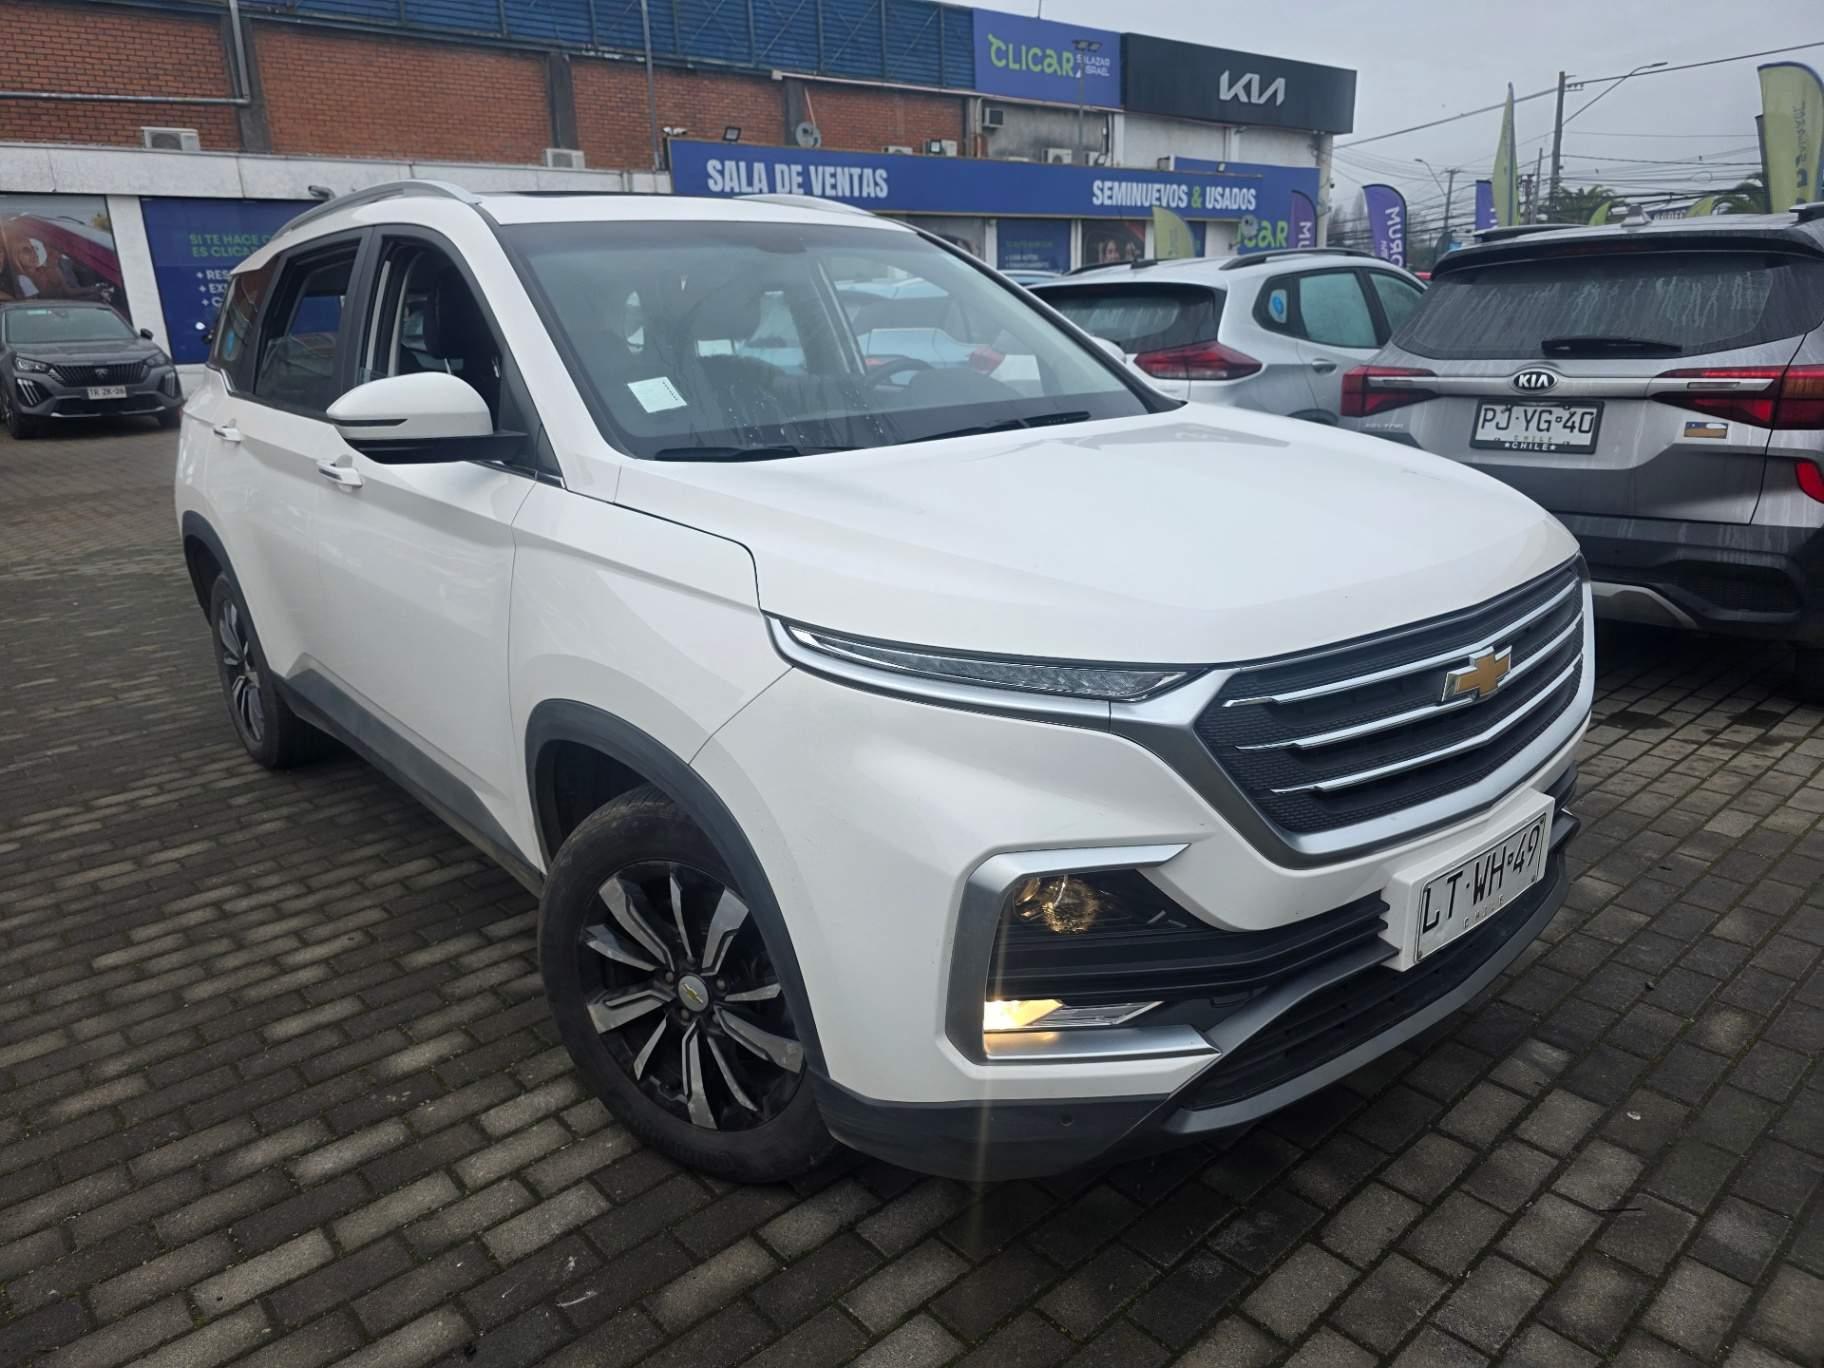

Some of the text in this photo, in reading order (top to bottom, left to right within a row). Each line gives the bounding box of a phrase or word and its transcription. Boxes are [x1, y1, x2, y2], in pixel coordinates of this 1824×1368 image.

[1219, 70, 1286, 106] KIA
[706, 159, 888, 198] SALA DE VENTAS
[1092, 180, 1256, 210] SEMINUEVOS & USADOS
[204, 234, 221, 245] TE
[223, 234, 257, 245] HACE
[192, 247, 208, 257] ES
[1518, 374, 1549, 387] KIA
[1511, 442, 1549, 451] CHILE
